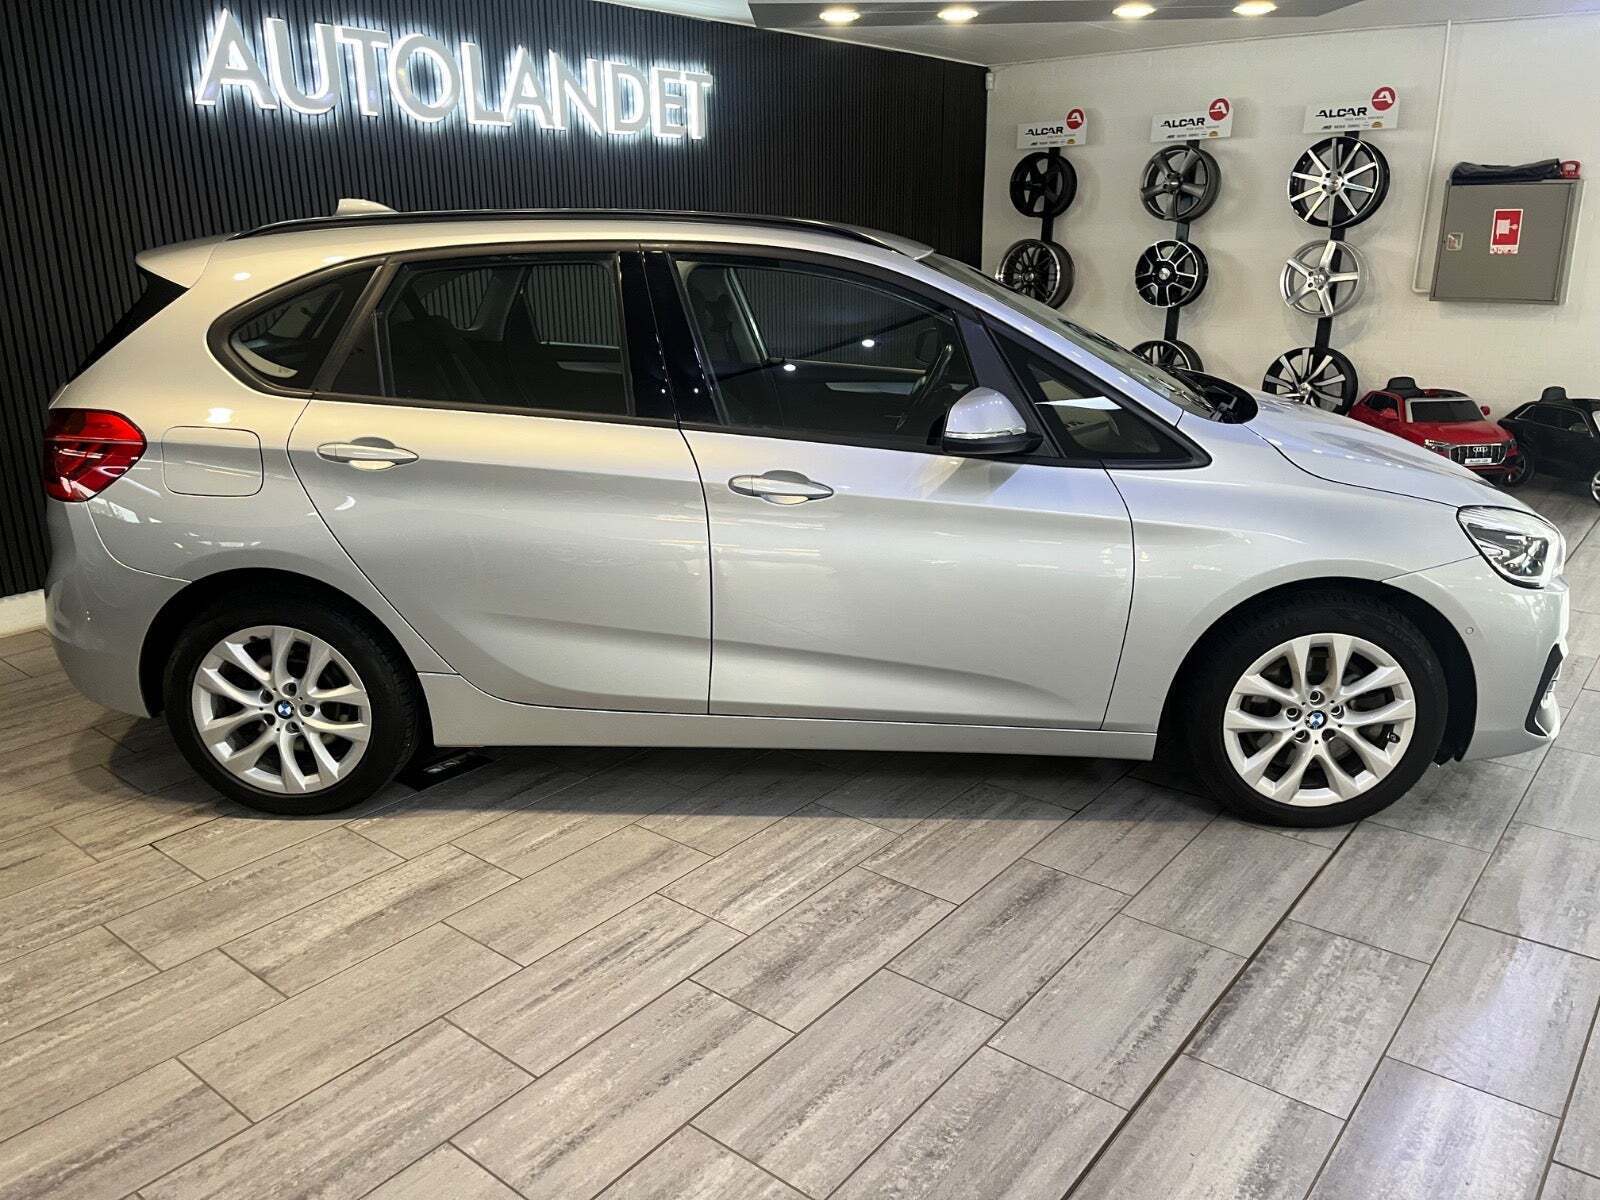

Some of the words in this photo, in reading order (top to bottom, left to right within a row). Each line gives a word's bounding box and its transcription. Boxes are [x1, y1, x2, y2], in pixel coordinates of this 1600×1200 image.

[194, 7, 713, 141] AUTOLANDET
[1315, 106, 1367, 118] ALCAR
[1160, 117, 1205, 128] ALCAR
[1024, 126, 1064, 136] ALCAR
